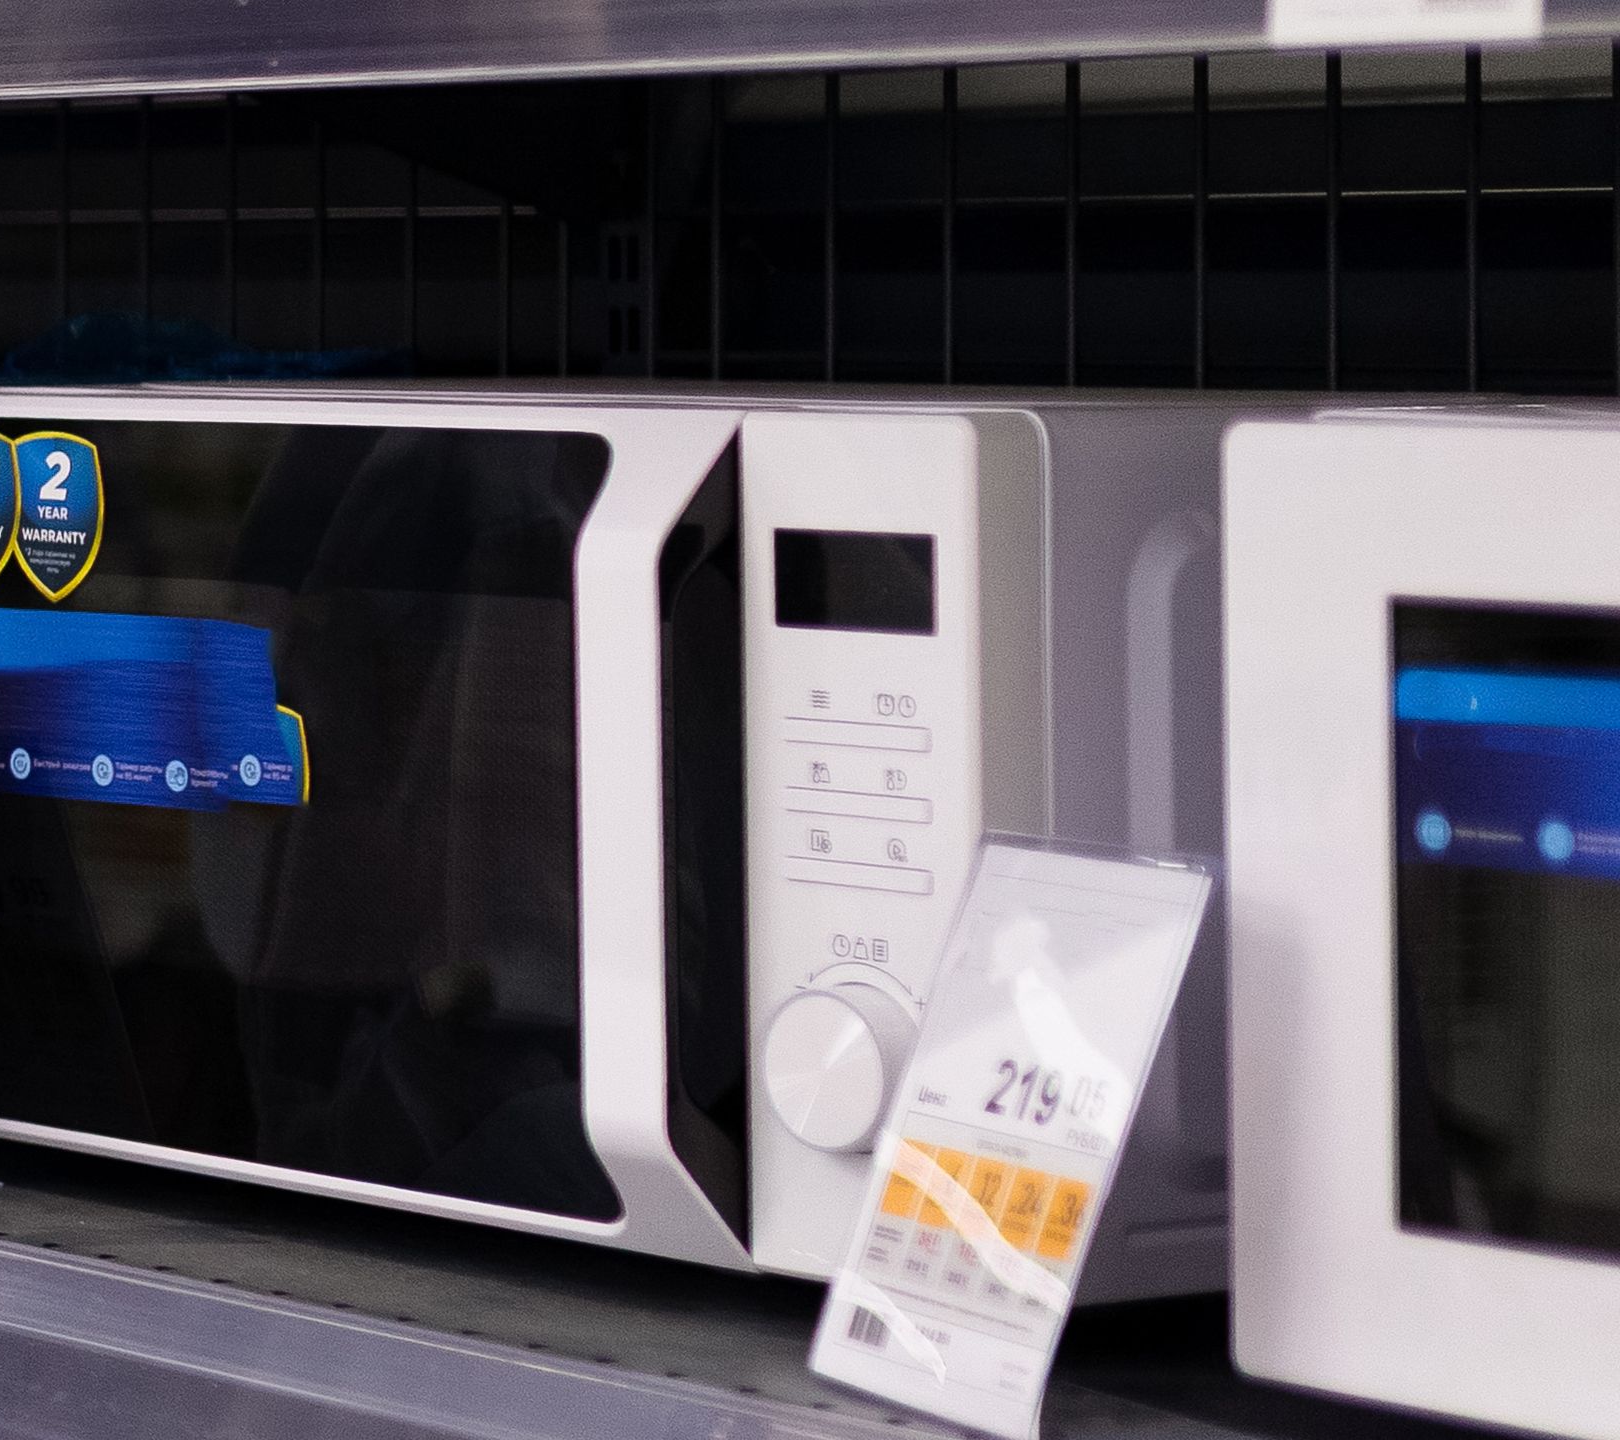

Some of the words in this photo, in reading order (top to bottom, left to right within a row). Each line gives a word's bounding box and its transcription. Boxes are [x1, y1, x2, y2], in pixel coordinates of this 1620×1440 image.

[39, 450, 72, 502] 2
[37, 504, 68, 521] YEAR
[21, 527, 87, 546] WARRANTY
[984, 1058, 1061, 1126] 219
